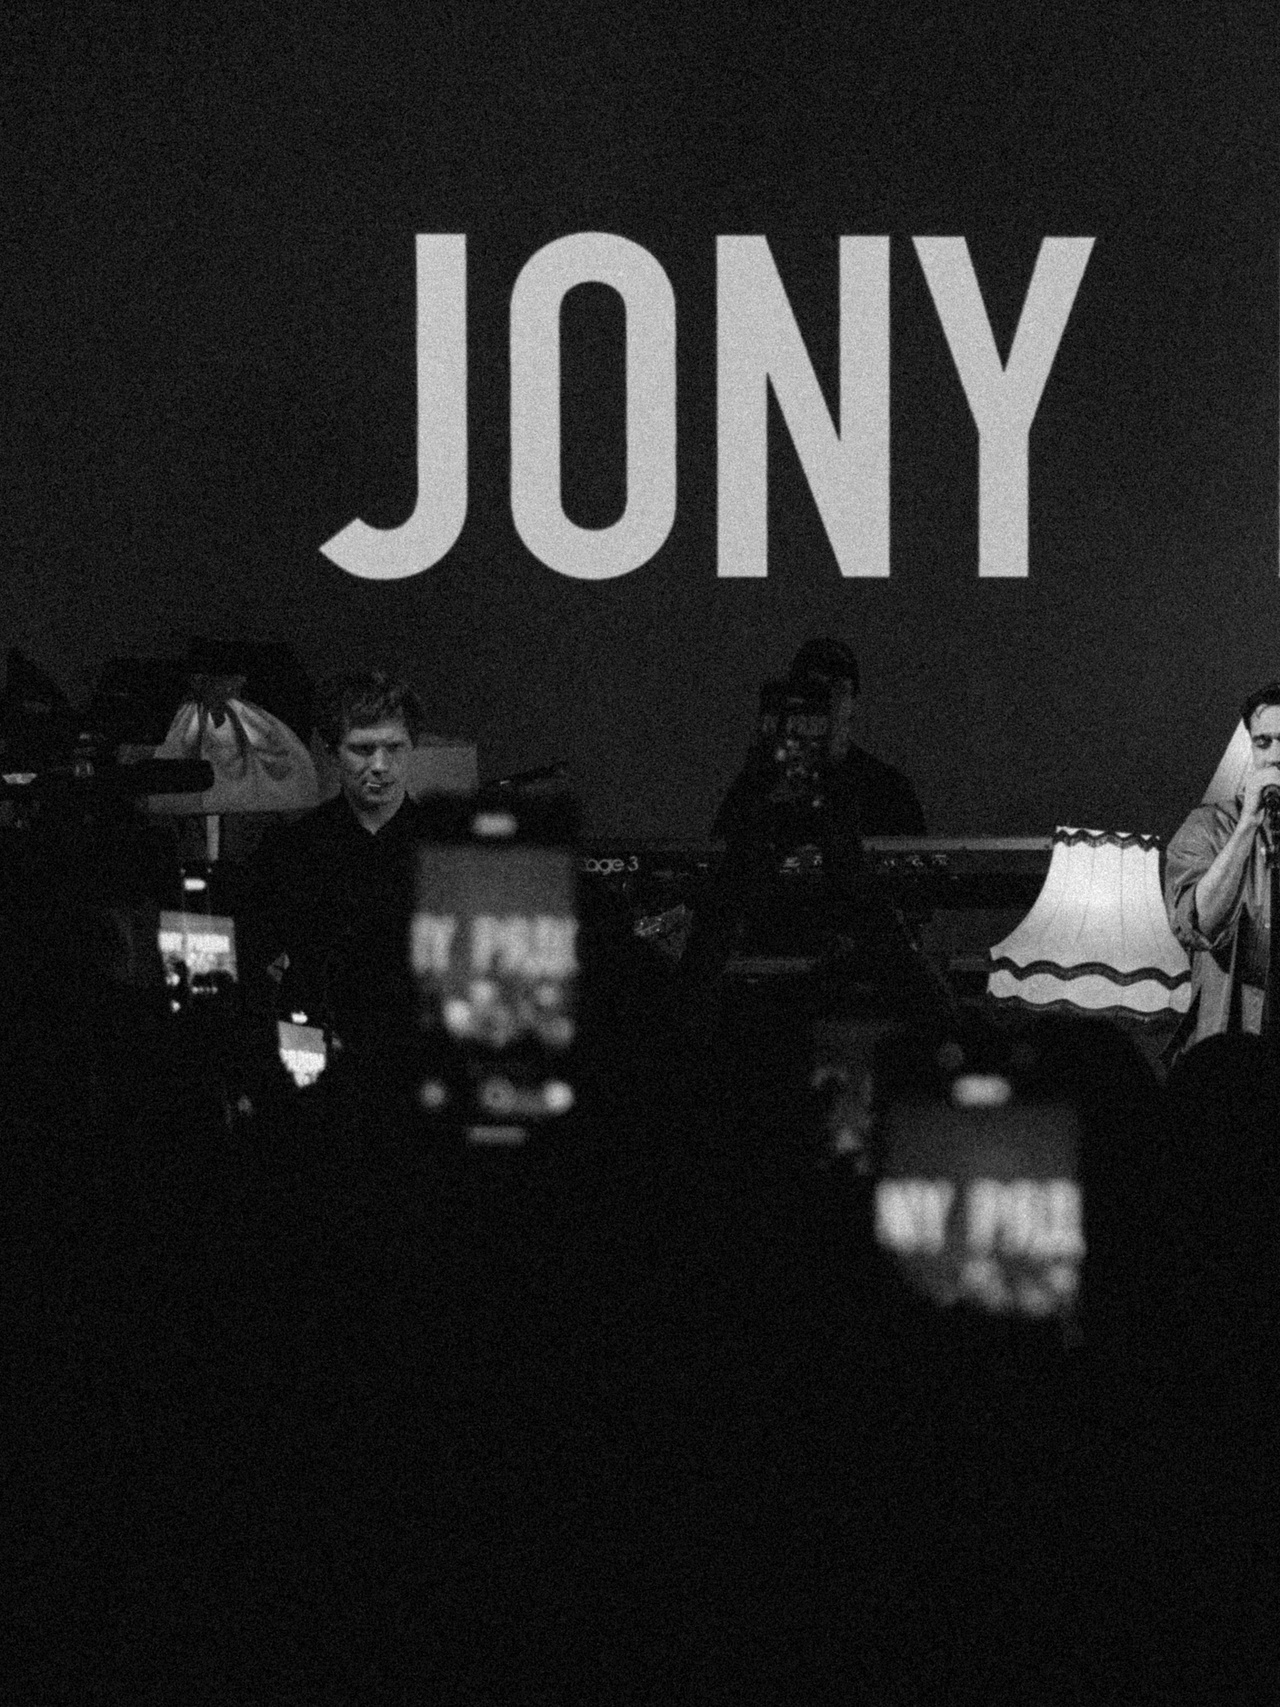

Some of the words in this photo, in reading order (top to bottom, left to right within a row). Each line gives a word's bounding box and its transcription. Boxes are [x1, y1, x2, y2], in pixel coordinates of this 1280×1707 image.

[319, 232, 1096, 580] JONY
[583, 858, 624, 875] age
[627, 856, 639, 872] 3
